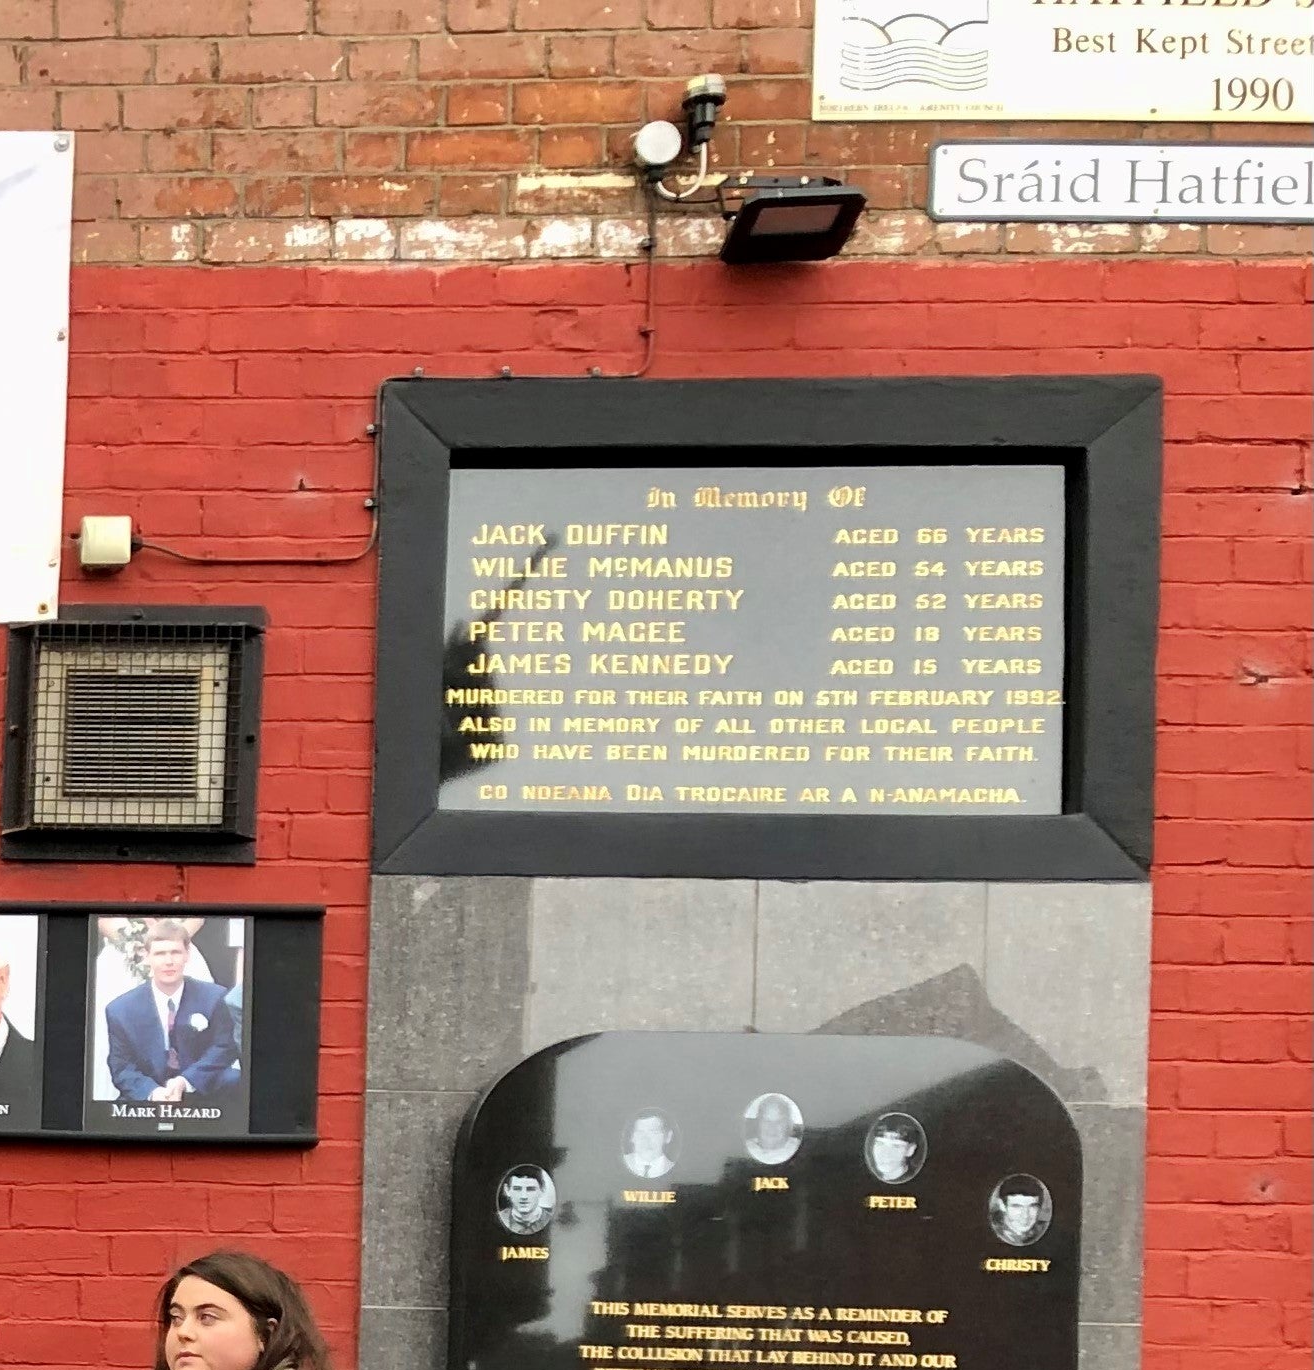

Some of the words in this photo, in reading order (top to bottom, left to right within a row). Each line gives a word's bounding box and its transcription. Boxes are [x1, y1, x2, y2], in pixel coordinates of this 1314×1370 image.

[1052, 27, 1116, 53] Best
[1136, 28, 1208, 60] Kept
[1212, 77, 1294, 111] 1990
[957, 158, 1099, 203] Sráid
[1126, 159, 1314, 205] Hatfiel
[646, 487, 676, 509] In
[692, 485, 808, 511] Memory
[826, 485, 865, 508] Of
[472, 524, 546, 546] JACK
[565, 523, 668, 547] DUFFIN
[833, 527, 899, 545] AGED
[914, 527, 948, 544] 66
[966, 527, 1044, 544] YEARS
[471, 555, 566, 579] WILLIE
[587, 556, 732, 579] McMANUS
[831, 560, 897, 579] AGED
[913, 560, 945, 577] 54
[964, 559, 1043, 577] YEARS
[469, 587, 590, 611] CHRISTY
[607, 588, 741, 612] DOHERTY
[832, 591, 897, 611] AGED
[914, 593, 946, 611] 52
[964, 592, 1044, 610] YEARS
[466, 620, 563, 643] PETER
[581, 620, 683, 643] MAGEE
[830, 625, 896, 643] AGED
[913, 625, 941, 643] 18
[963, 624, 1042, 643] YEARS
[466, 652, 571, 676] JAMES
[588, 653, 732, 675] KENNEDY
[829, 657, 894, 676] AGED
[912, 658, 937, 676] 15
[961, 657, 1042, 676] YEARS
[444, 687, 564, 707] MURDERED
[573, 689, 616, 705] FOR
[627, 689, 687, 706] THEIR
[698, 690, 763, 705] FAITH
[773, 690, 804, 706] ON
[816, 690, 857, 706] 5TH
[868, 689, 992, 707] FEBRUARY
[457, 716, 517, 735] ALSO
[528, 716, 551, 732] IN
[562, 716, 658, 734] MEMORY
[674, 717, 701, 733] OF
[715, 718, 751, 735] ALL
[769, 717, 845, 734] OTHER
[859, 716, 934, 734] LOCAL
[950, 717, 1042, 734] PEOPLE
[468, 742, 520, 761] WHO
[532, 744, 590, 760] HAVE
[606, 744, 668, 761] BEEN
[680, 744, 809, 762] MURDERED
[823, 745, 870, 762] FOR
[884, 745, 952, 762] THEIR
[964, 745, 1033, 761] FAITH.
[111, 1103, 156, 1117] MARK
[159, 1104, 221, 1118] HAZARD
[753, 1176, 789, 1191] JACK
[620, 1188, 676, 1204] WILLIE
[868, 1195, 917, 1208] PETER
[501, 1245, 550, 1261] JAMES
[984, 1258, 1051, 1271] CHRISTY
[589, 1301, 630, 1315] THIS
[633, 1302, 723, 1318] MEMORIAL
[723, 1304, 787, 1319] SERVES
[789, 1306, 815, 1320] AS
[817, 1307, 833, 1320] A
[835, 1307, 923, 1323] REMINDER
[925, 1309, 948, 1323] OF
[625, 1324, 661, 1338] THE
[664, 1325, 754, 1340] SUFFERING
[757, 1327, 804, 1342] THAT
[805, 1328, 843, 1343] WAS
[578, 1345, 613, 1359] THE
[616, 1346, 703, 1361] COLLUSION
[706, 1348, 753, 1363] THAT
[755, 1350, 790, 1363] LAY
[790, 1350, 854, 1365] BEHIND
[857, 1352, 876, 1366] IT
[878, 1353, 917, 1367] AND
[920, 1354, 957, 1368] OUR
